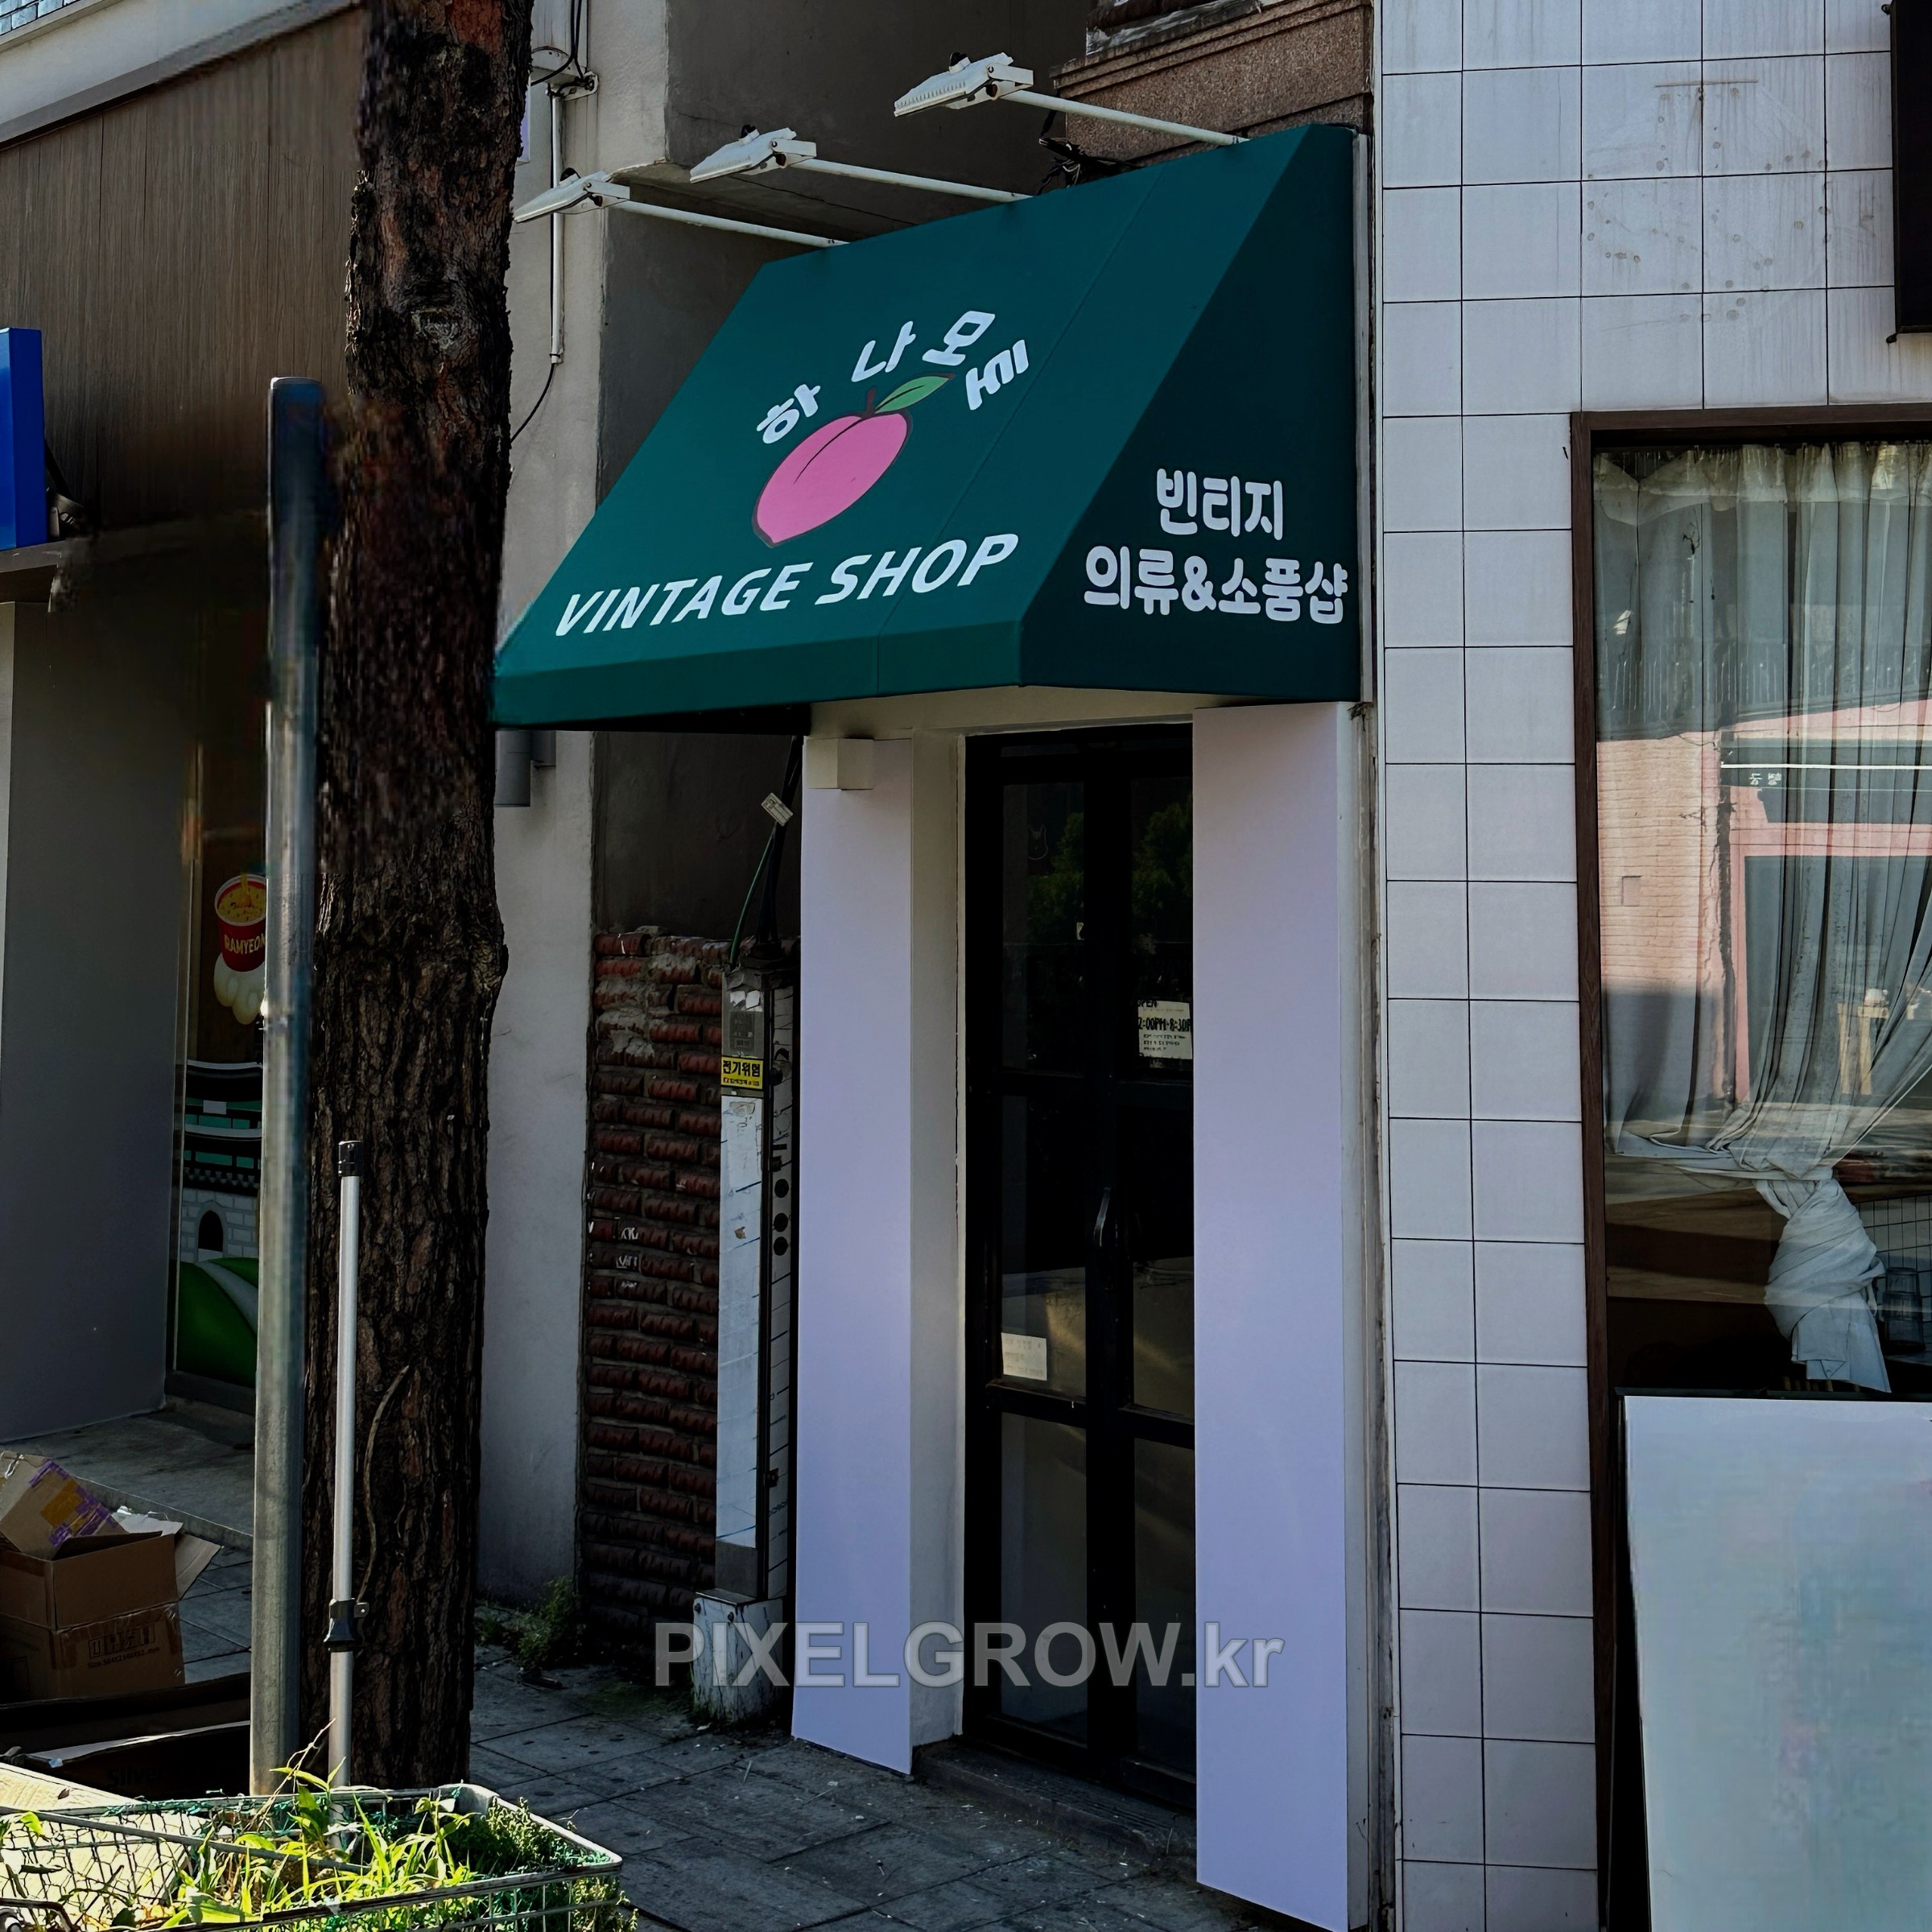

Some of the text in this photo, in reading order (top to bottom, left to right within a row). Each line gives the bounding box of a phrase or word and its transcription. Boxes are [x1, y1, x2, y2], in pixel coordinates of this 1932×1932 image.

[1157, 469, 1282, 540] 빈티지
[555, 533, 1019, 636] VINTAGE SHOP
[1084, 546, 1348, 624] 의류&소품샵
[723, 1060, 760, 1077] 전기위험
